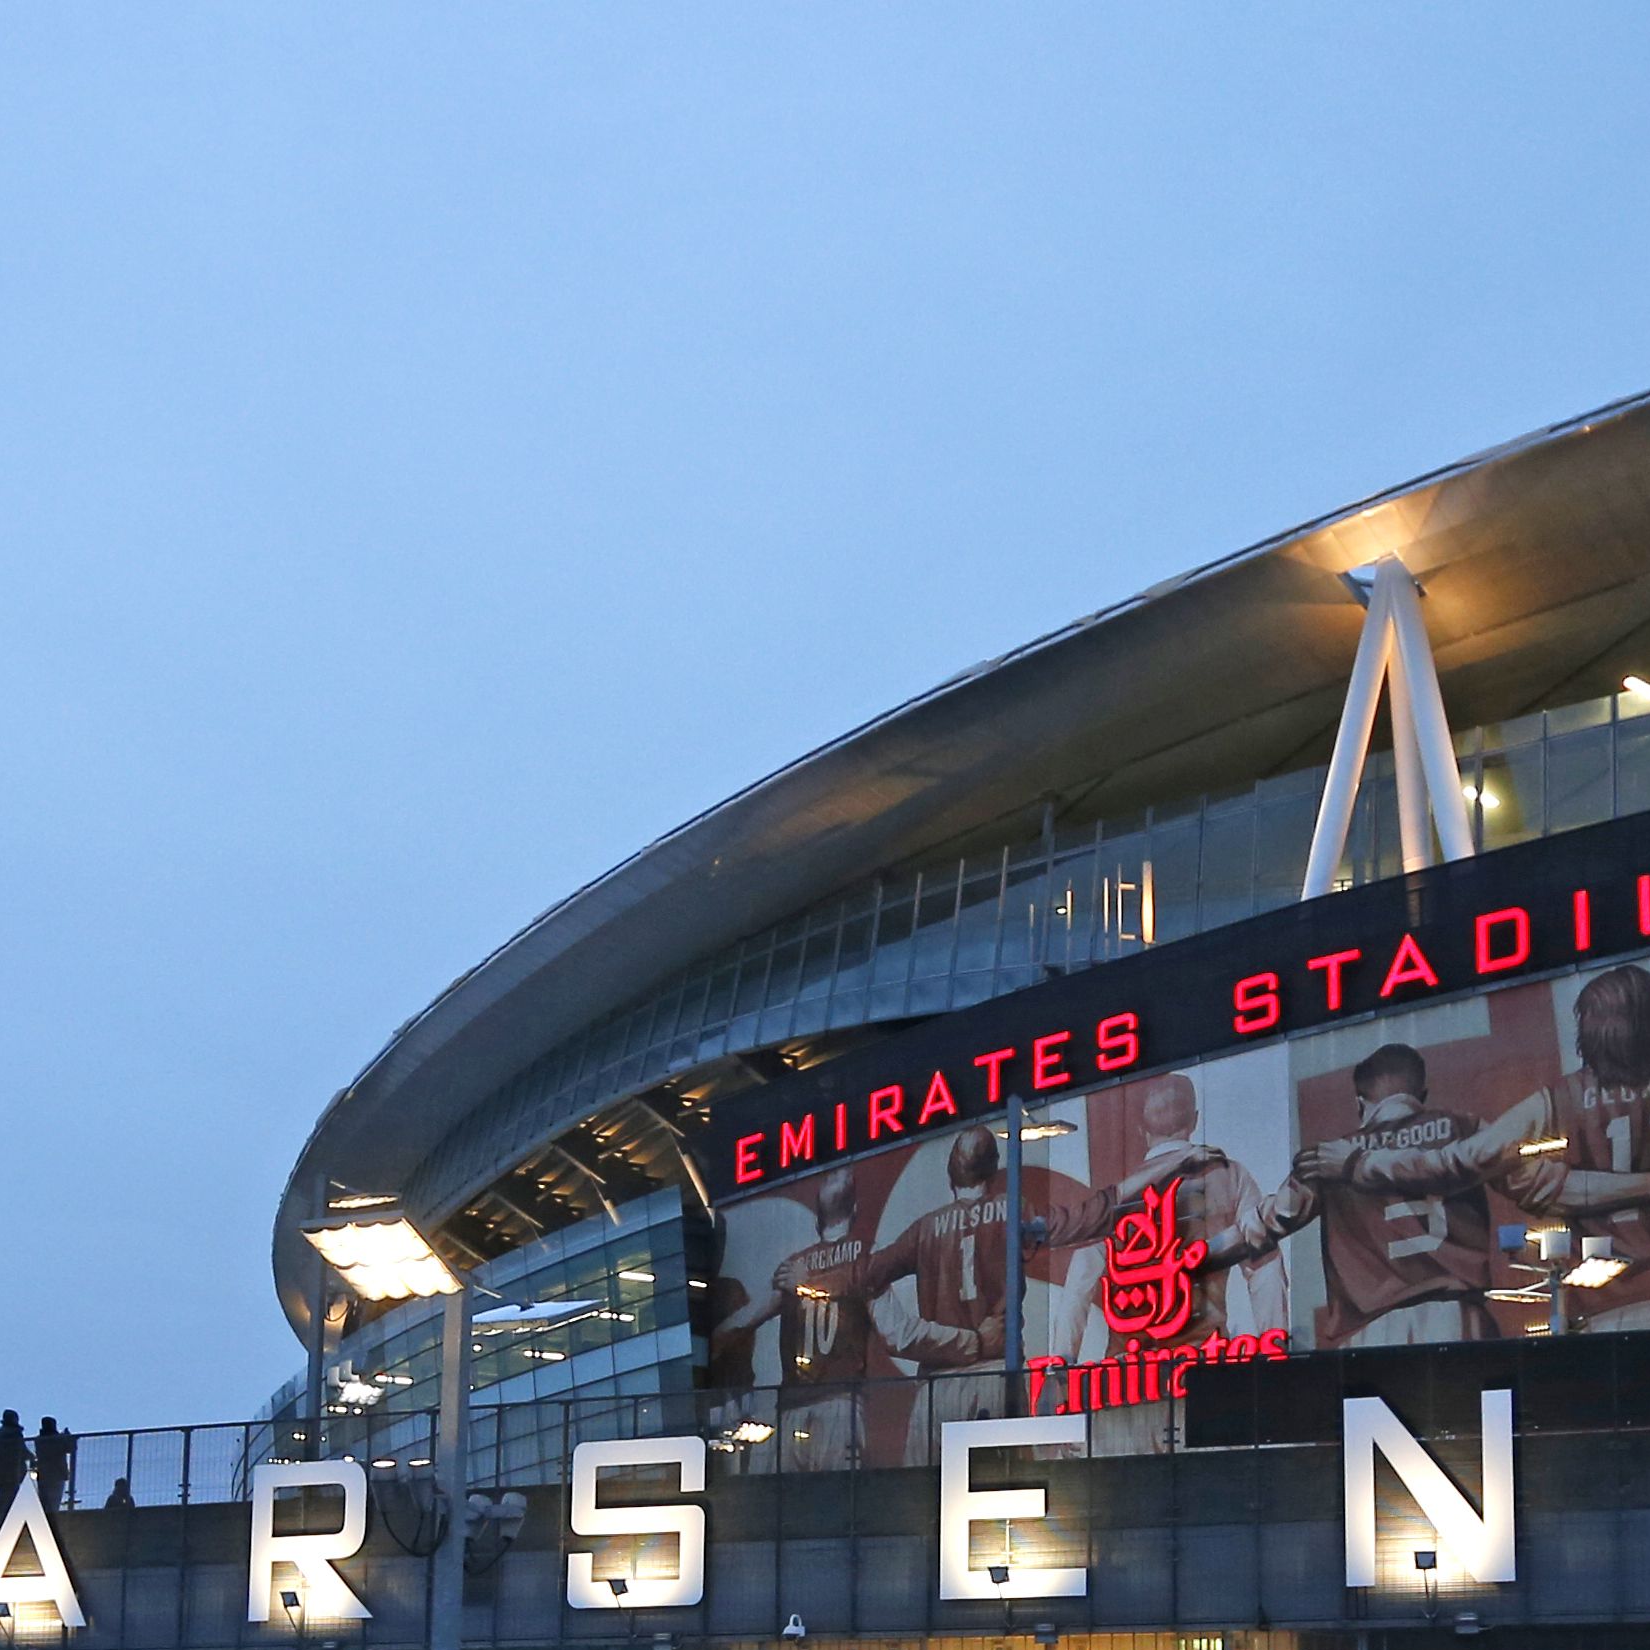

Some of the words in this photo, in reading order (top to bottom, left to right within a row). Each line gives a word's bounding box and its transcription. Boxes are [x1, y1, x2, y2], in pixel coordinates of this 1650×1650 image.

[735, 1011, 1139, 1184] EMIRATES
[934, 1200, 1007, 1238] WILSON
[959, 1235, 978, 1301] 1
